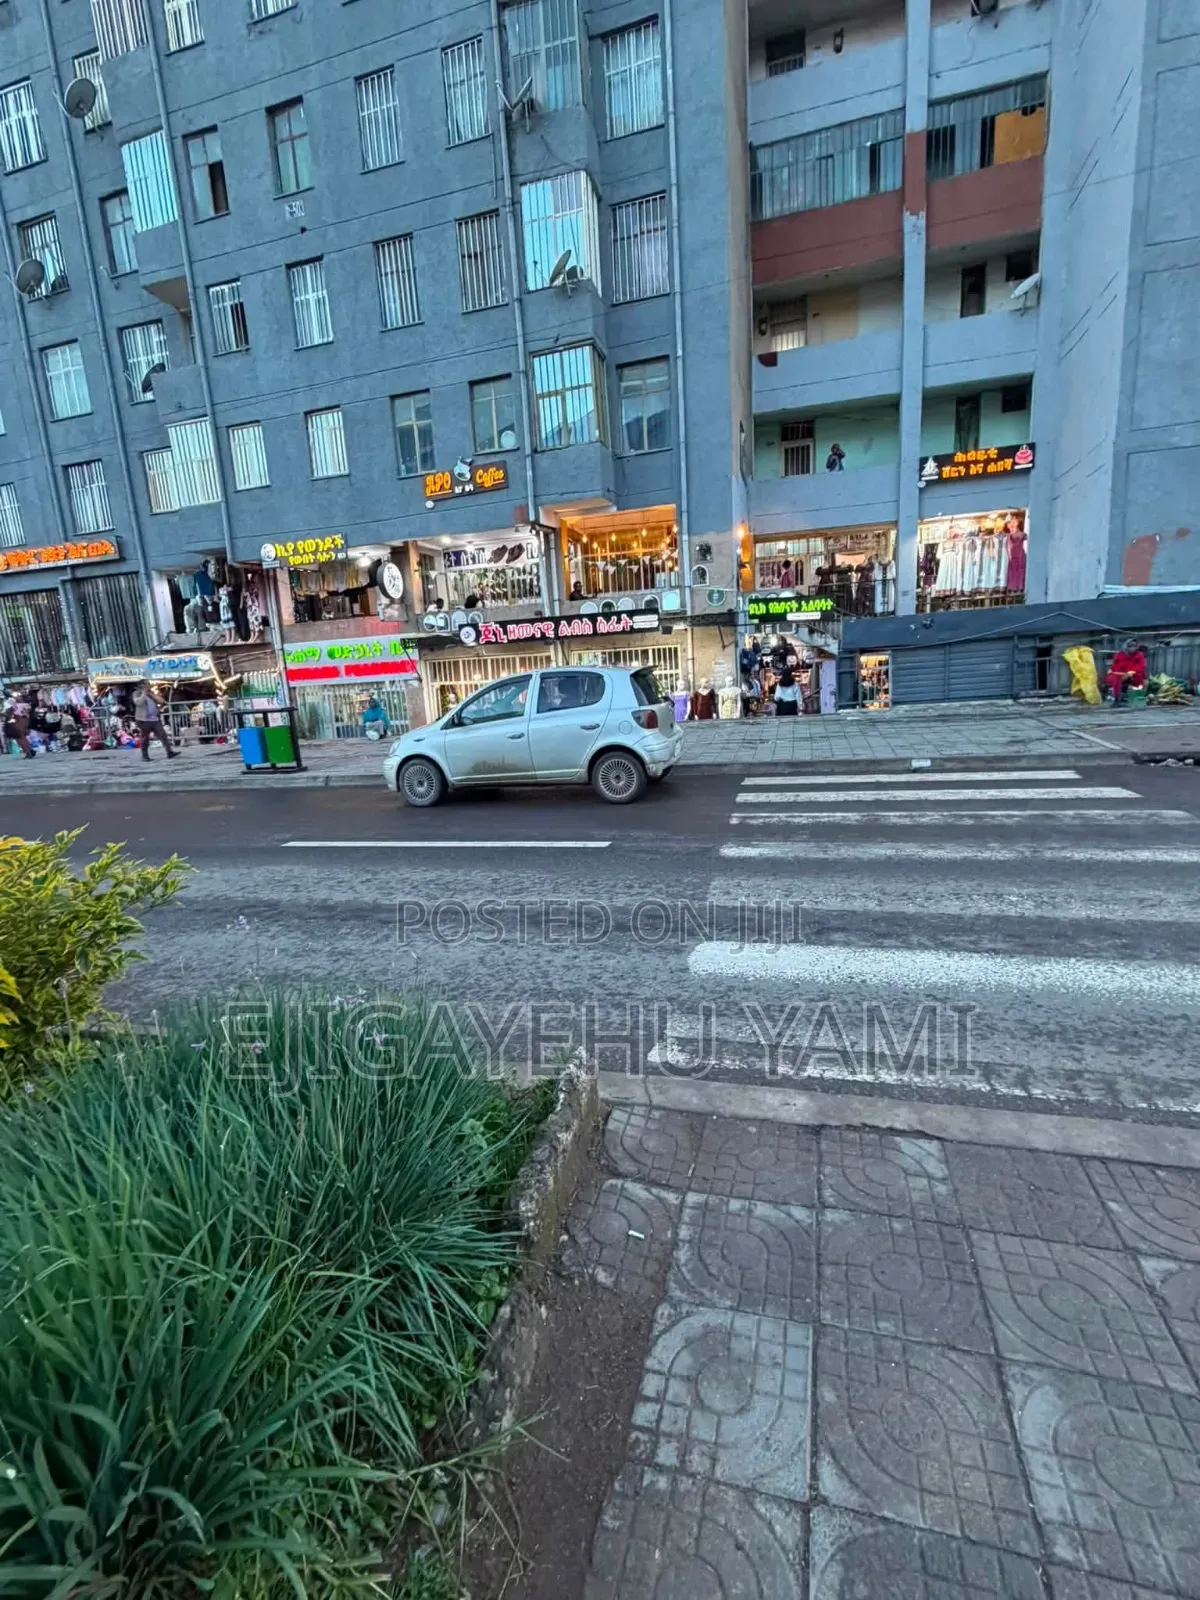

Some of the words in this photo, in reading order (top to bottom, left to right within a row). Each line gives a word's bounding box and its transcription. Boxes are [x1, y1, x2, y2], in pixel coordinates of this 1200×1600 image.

[476, 467, 505, 488] Coffee
[507, 620, 555, 641] ዘመናዊ
[557, 617, 593, 637] ልብስ
[596, 613, 633, 635] ስፌት
